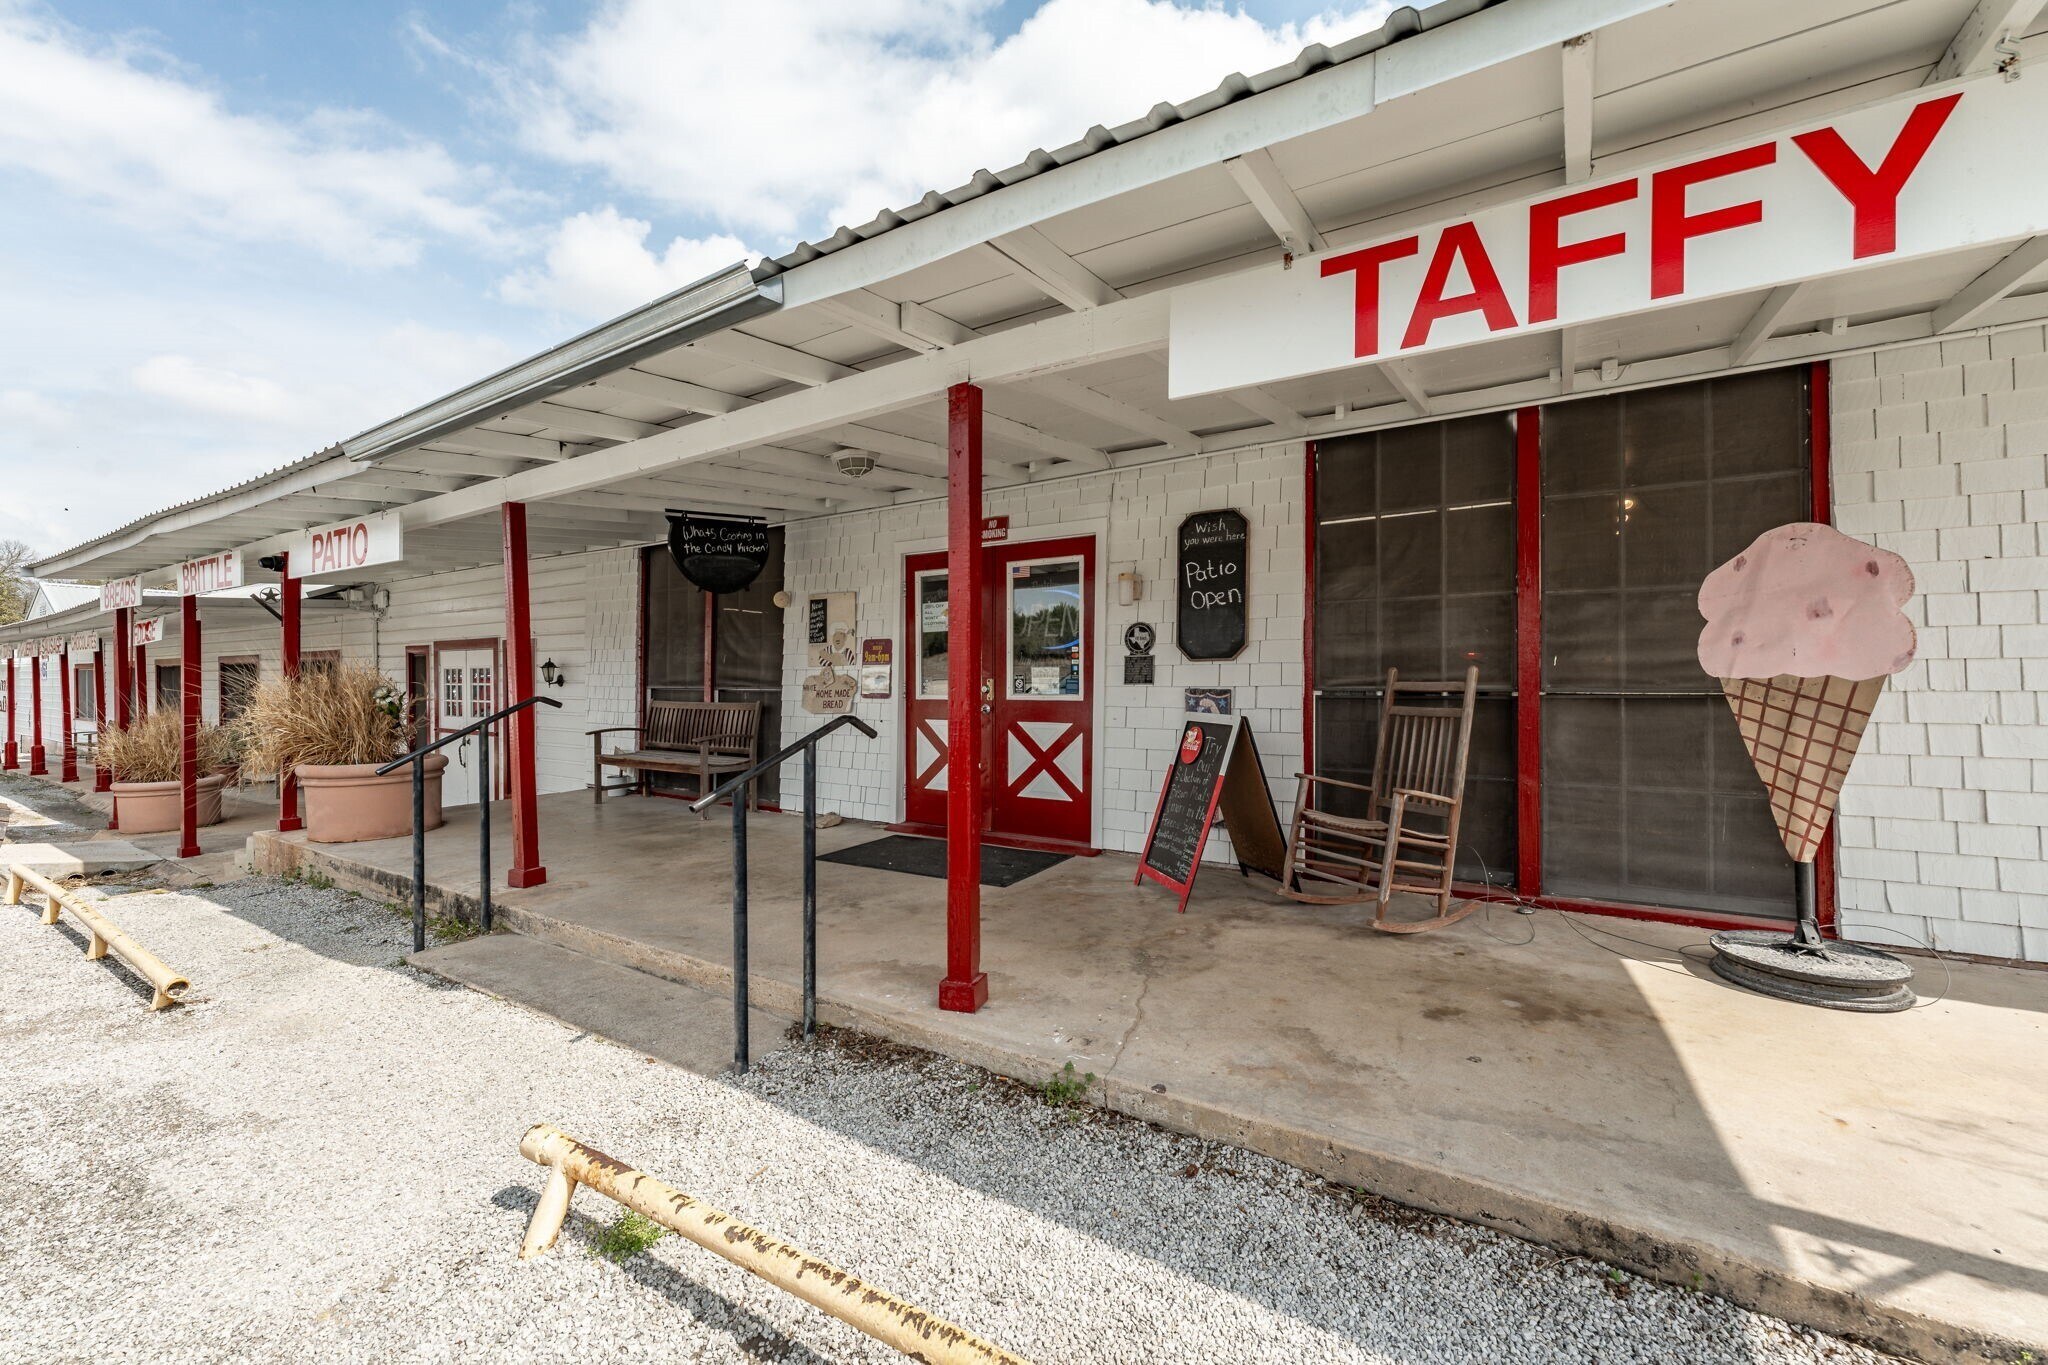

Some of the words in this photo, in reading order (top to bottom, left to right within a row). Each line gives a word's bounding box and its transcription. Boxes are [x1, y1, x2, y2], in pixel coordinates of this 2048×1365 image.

[1320, 92, 1964, 358] TAFFY
[988, 520, 998, 529] NO
[1195, 518, 1226, 533] Wish
[312, 523, 369, 573] PATIO
[683, 543, 702, 555] the
[704, 542, 733, 554] Candy
[1184, 537, 1200, 551] you
[1202, 535, 1223, 544] were
[1226, 529, 1246, 541] here
[182, 553, 233, 595] BRITTLE
[1185, 560, 1237, 588] Patio
[104, 579, 136, 609] BREADS
[1191, 588, 1242, 610] Open
[864, 651, 890, 664] 9am-6pm
[816, 689, 832, 698] HOME
[834, 689, 850, 698] MADE
[823, 700, 843, 709] BREAD
[1205, 736, 1222, 762] Try
